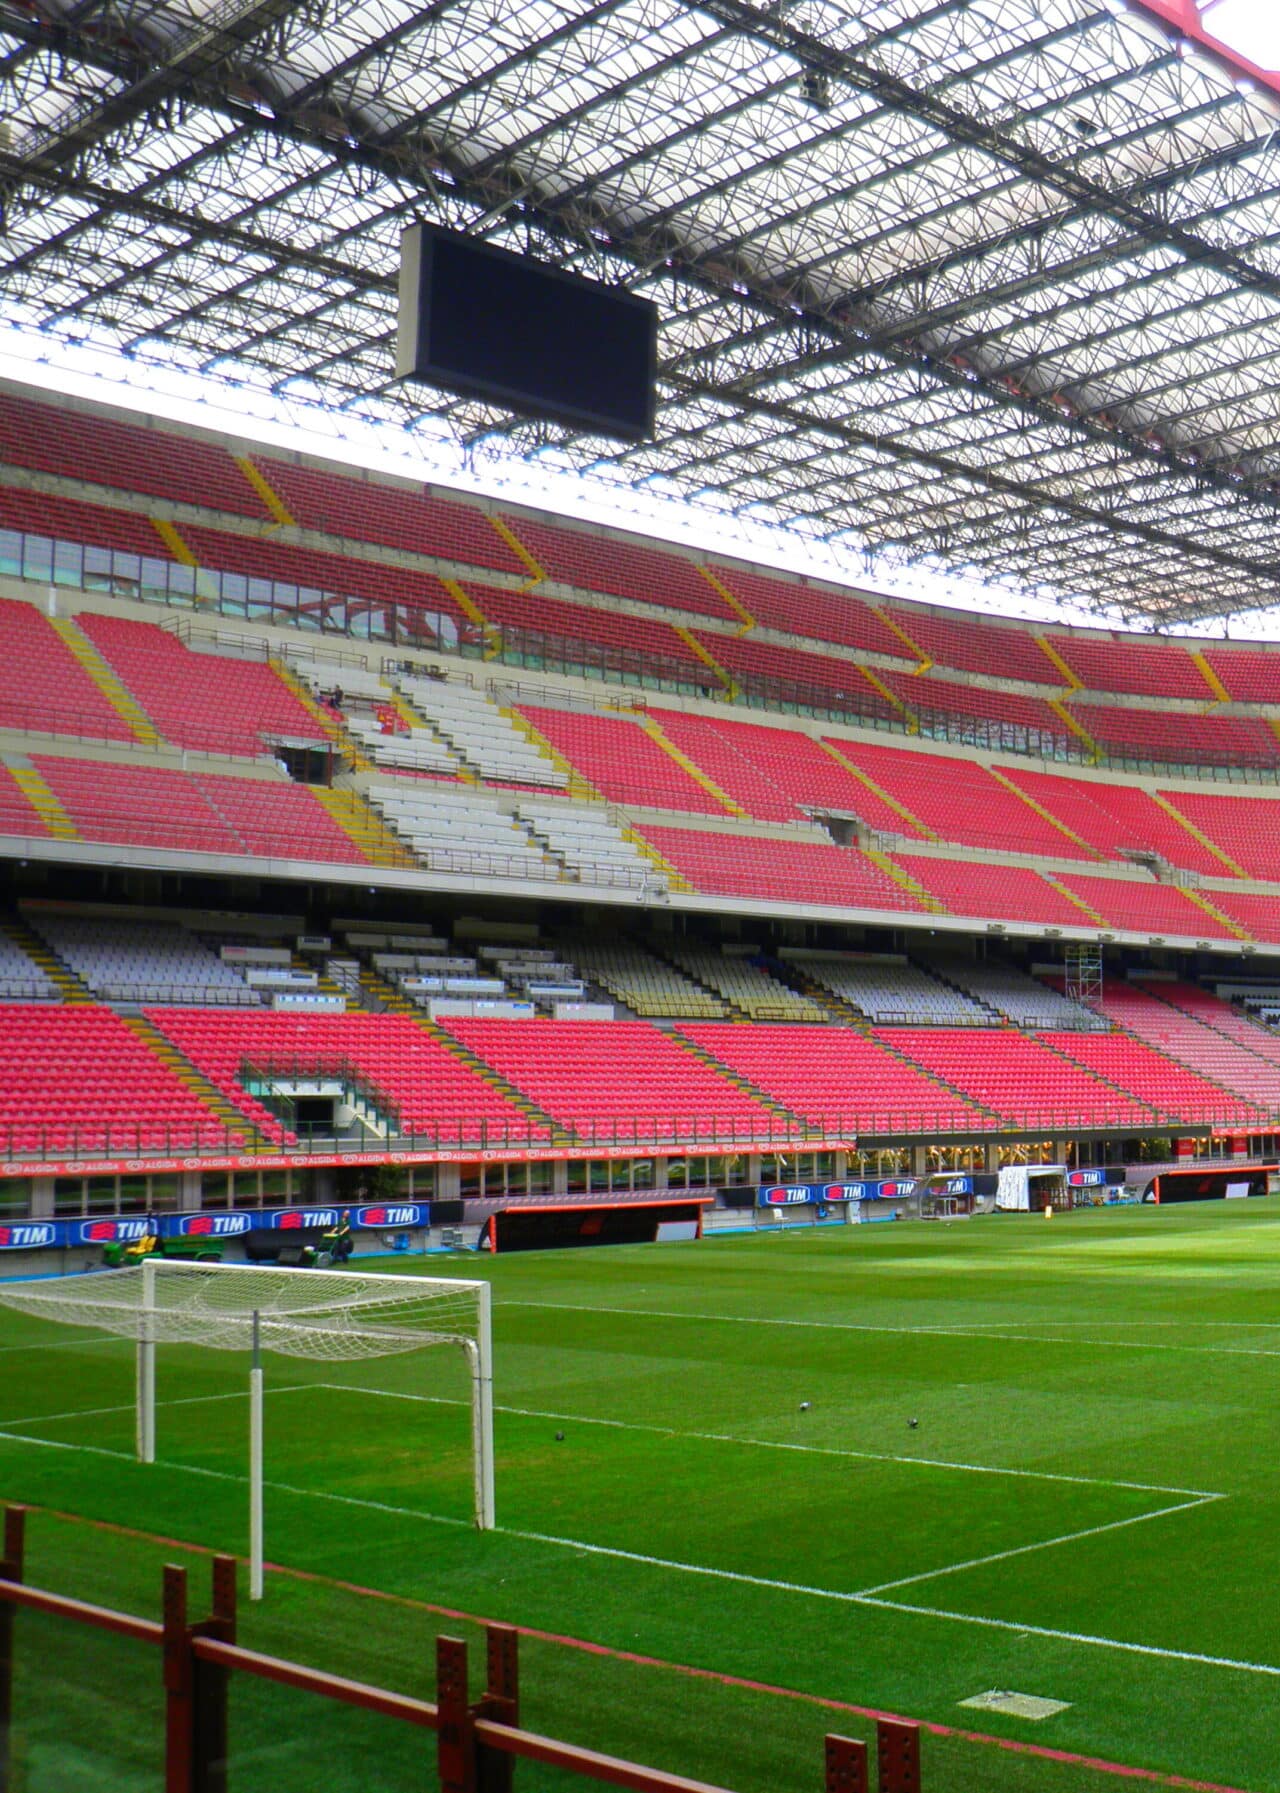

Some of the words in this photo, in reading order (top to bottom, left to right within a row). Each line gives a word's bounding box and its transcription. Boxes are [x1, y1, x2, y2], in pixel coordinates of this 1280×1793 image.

[357, 1154, 385, 1163] ALGIDA
[406, 1153, 433, 1161] ALGIDA
[453, 1152, 477, 1160] ALGIDA
[496, 1151, 521, 1159] ALGIDA
[146, 1160, 177, 1168] ALGIDA
[202, 1158, 232, 1167] ALGIDA
[255, 1156, 286, 1165] ALGIDA
[23, 1164, 58, 1173] ALGIDA
[86, 1162, 119, 1171] ALGIDA
[1083, 1173, 1098, 1183] TIM
[842, 1186, 863, 1198] TIM
[896, 1183, 914, 1194] TIM
[786, 1189, 807, 1201] TIM
[303, 1212, 332, 1227] TIM
[387, 1208, 414, 1223] TIM
[117, 1221, 150, 1238] TIM
[214, 1217, 245, 1233] TIM
[12, 1226, 49, 1244] TIM
